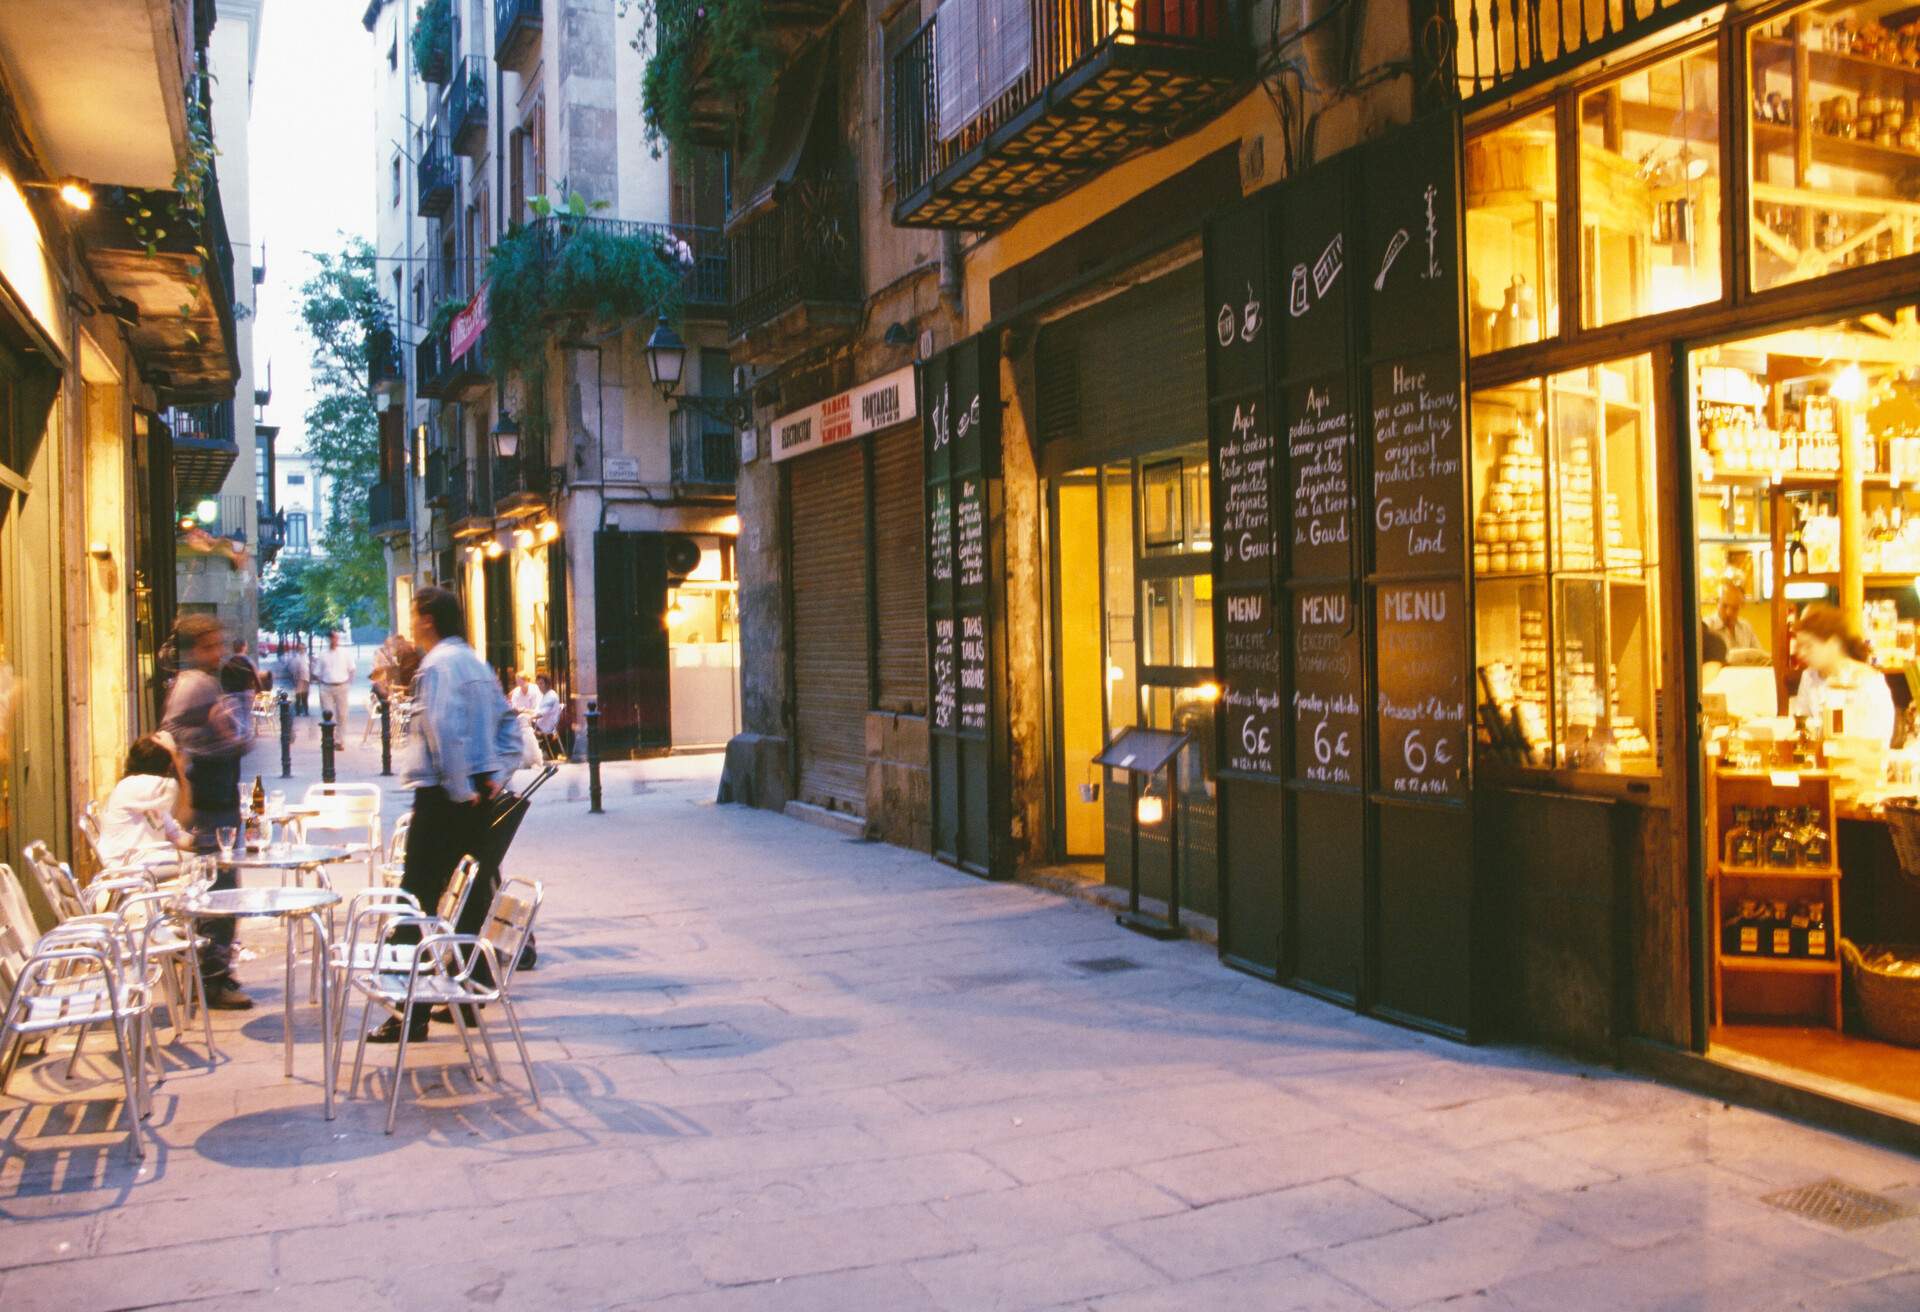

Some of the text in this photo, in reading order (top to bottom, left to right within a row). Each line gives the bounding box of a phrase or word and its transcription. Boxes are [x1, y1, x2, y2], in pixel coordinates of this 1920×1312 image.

[1393, 366, 1426, 395] Here
[1394, 402, 1414, 417] can
[1377, 413, 1452, 443] eat and buy
[1385, 432, 1437, 464] original
[1375, 457, 1426, 500] products
[1227, 594, 1262, 623] MENU
[1302, 595, 1345, 624] MENU
[1384, 591, 1446, 622] MENU
